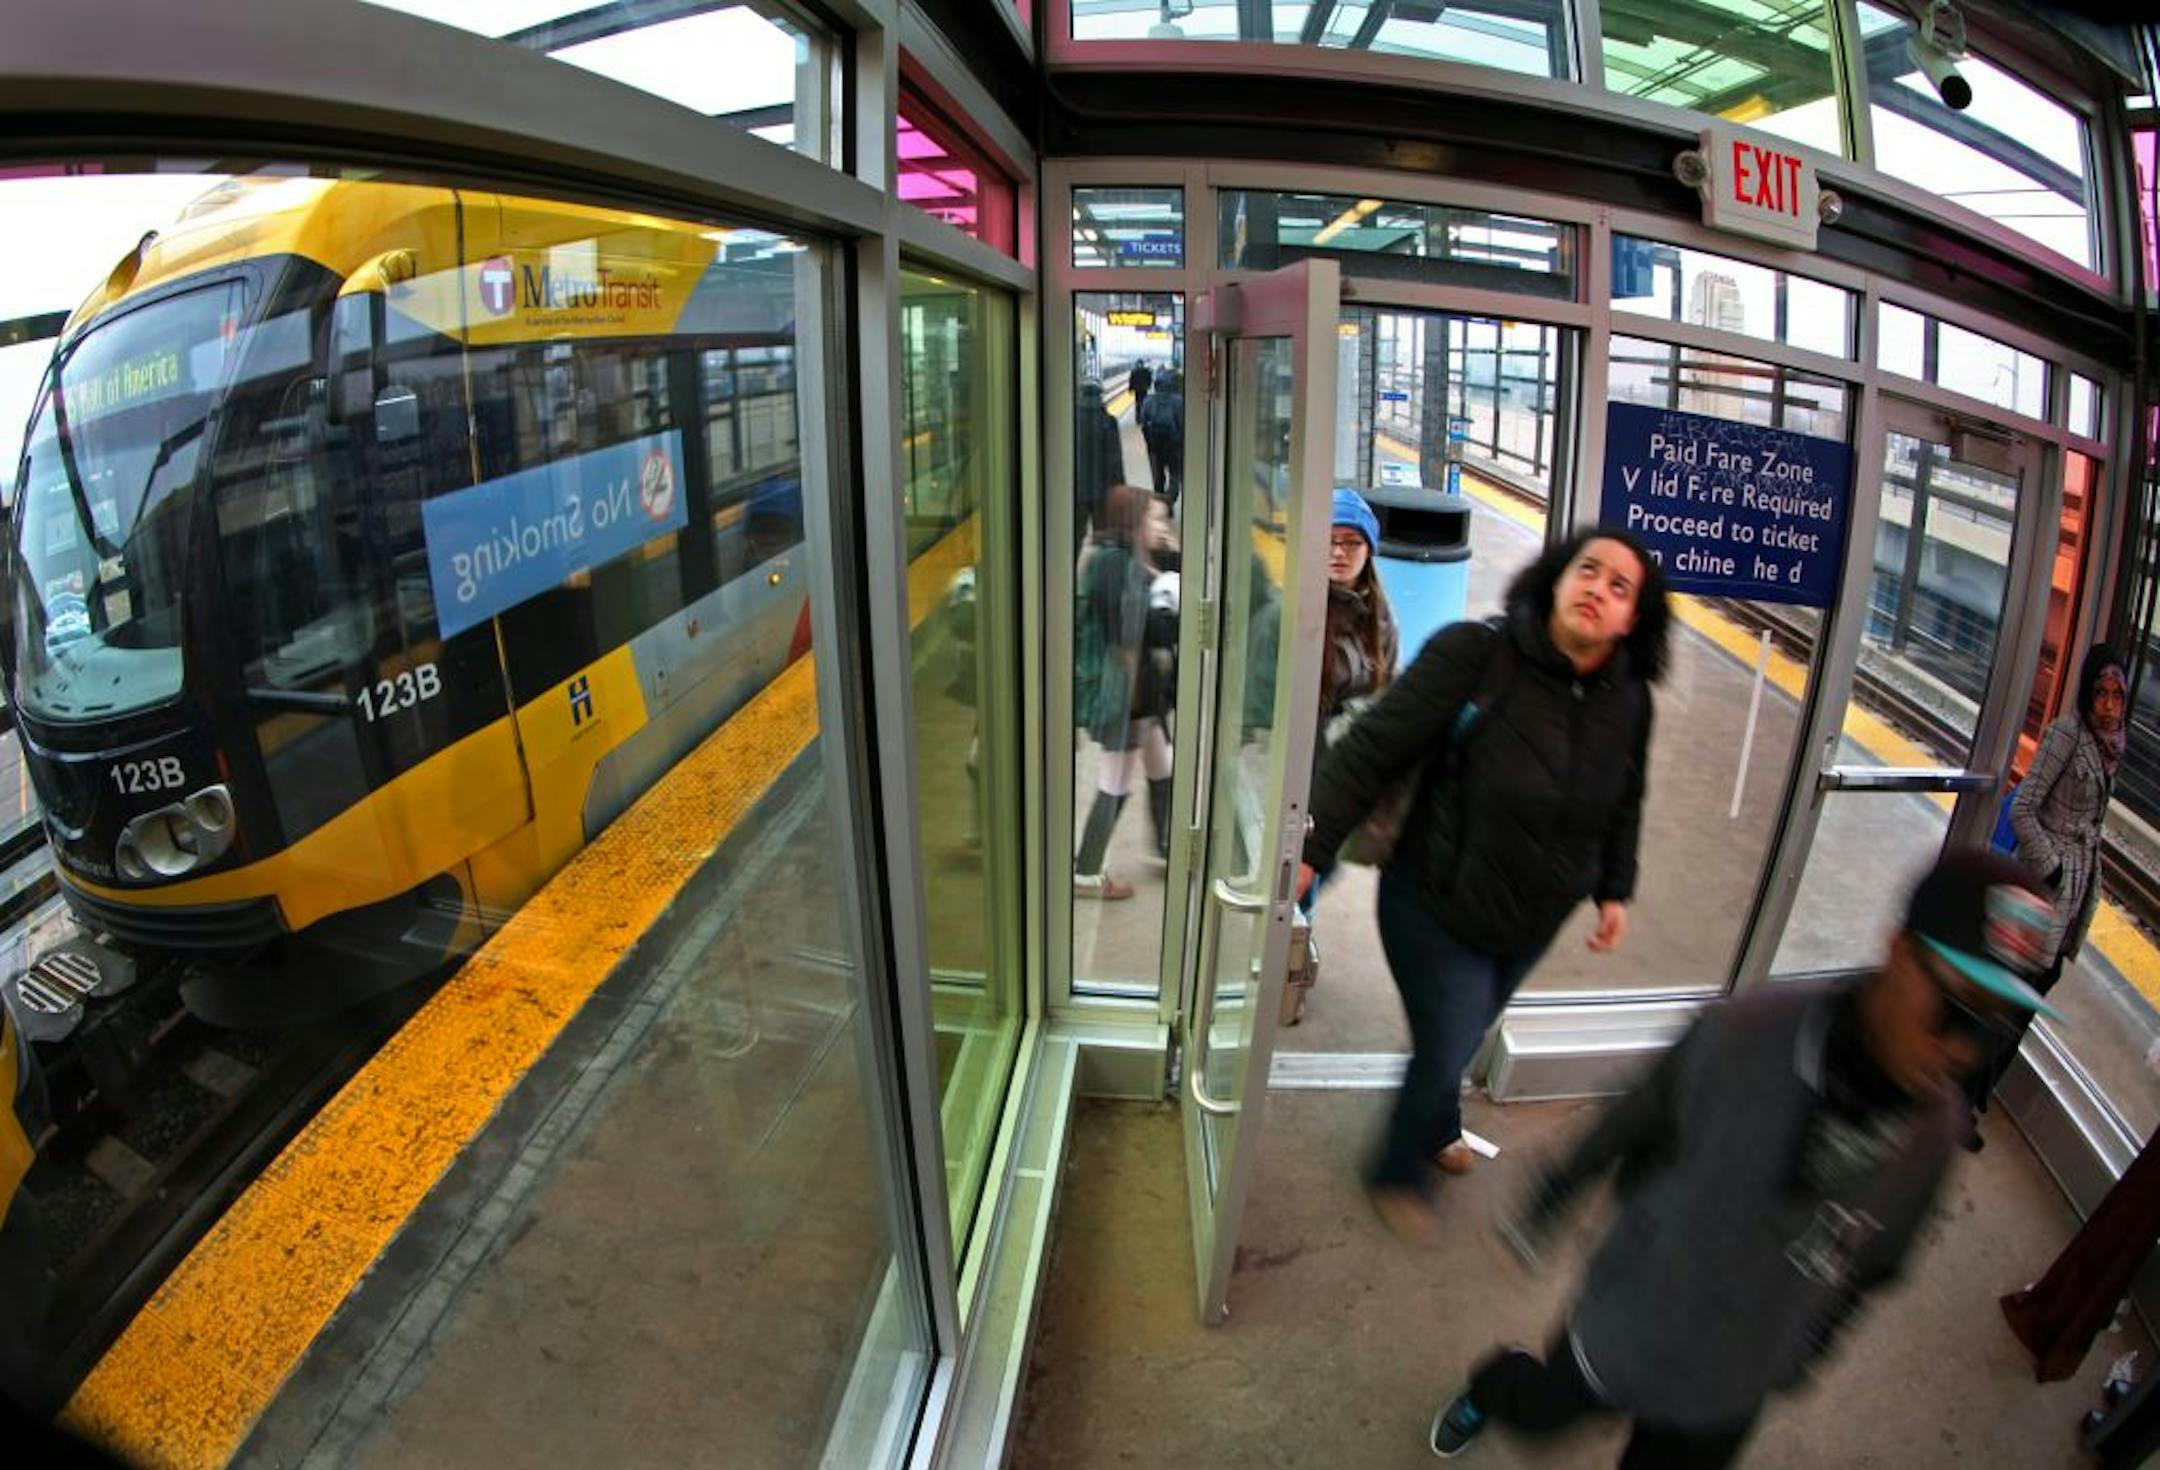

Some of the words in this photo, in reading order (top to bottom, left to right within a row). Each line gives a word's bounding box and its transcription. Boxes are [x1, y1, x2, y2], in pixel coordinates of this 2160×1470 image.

[1732, 141, 1802, 217] EXIT
[1130, 241, 1181, 255] TICKETS
[107, 368, 120, 406] of
[1650, 433, 1698, 465] Paid
[1705, 442, 1753, 474] Fare
[1761, 450, 1814, 484] Zone
[1622, 465, 1679, 499] Vlid
[1686, 475, 1735, 506] Fre
[1742, 484, 1833, 521] Required
[1627, 503, 1725, 540] Proceed
[1731, 522, 1755, 544] to
[1762, 523, 1820, 553] ticket
[356, 662, 443, 718] 123B
[110, 756, 186, 794] 123B
